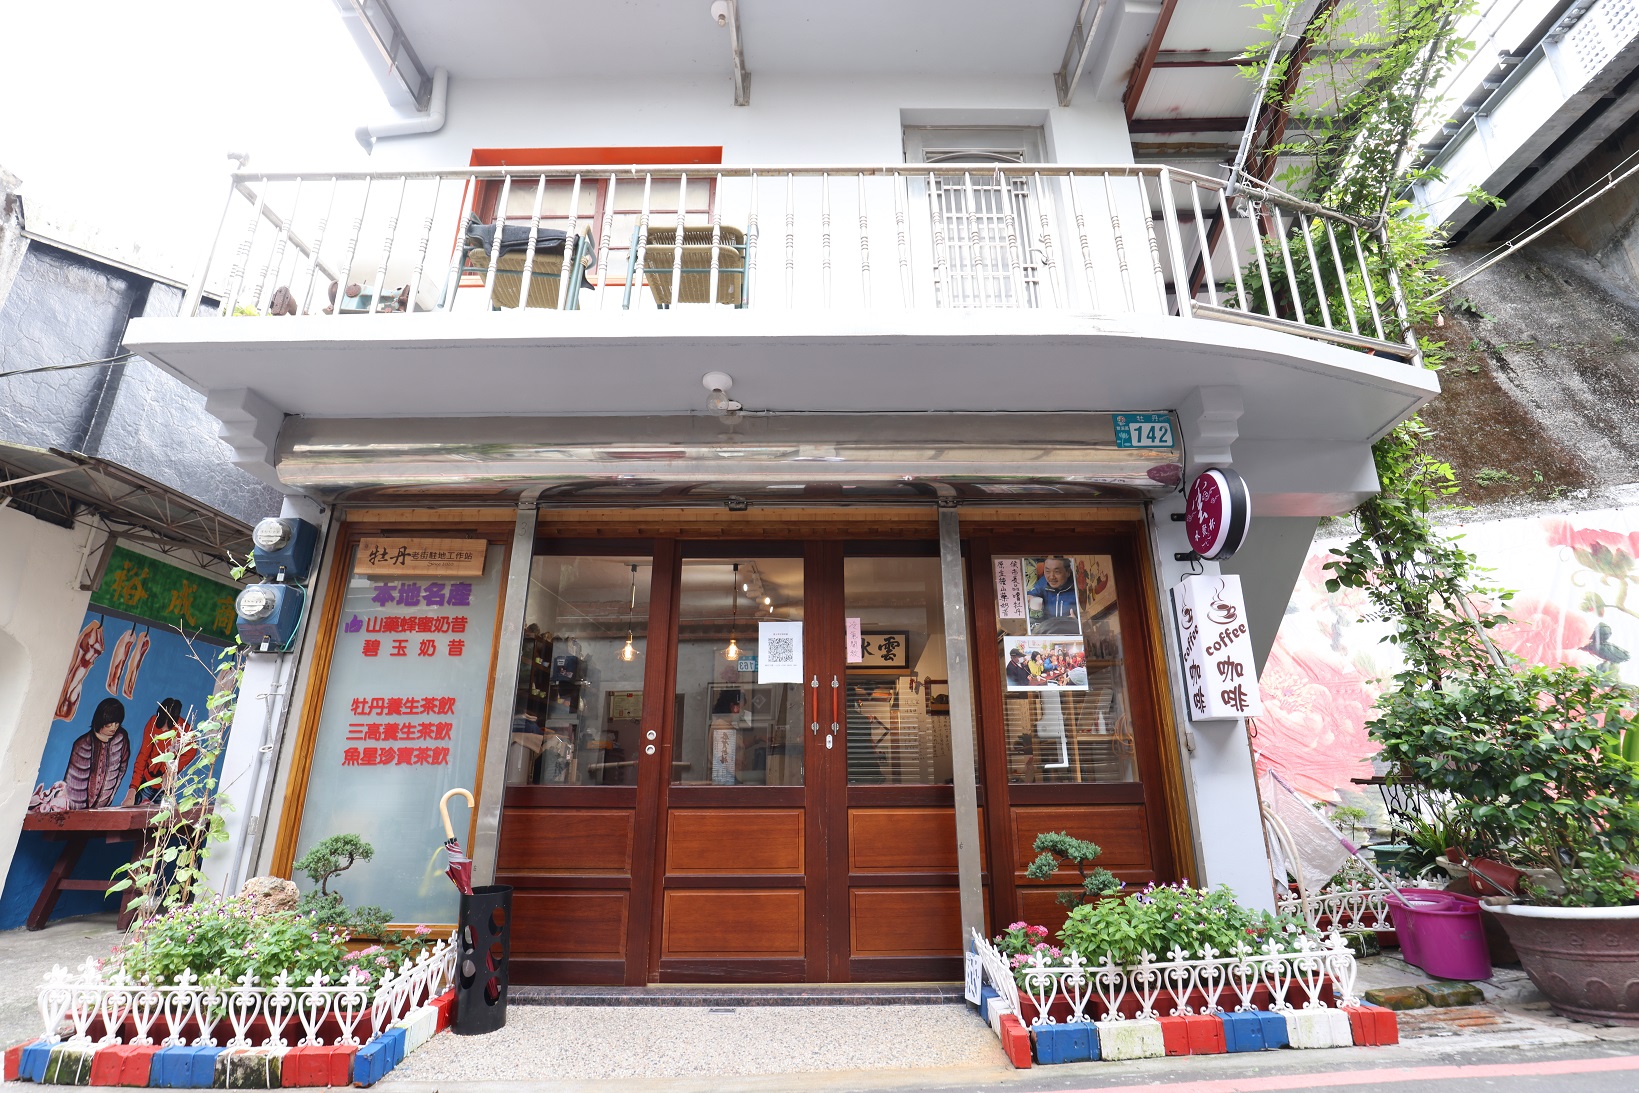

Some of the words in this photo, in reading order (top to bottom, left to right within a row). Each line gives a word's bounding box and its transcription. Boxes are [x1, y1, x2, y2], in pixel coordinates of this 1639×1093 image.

[1134, 426, 1168, 443] 142
[368, 545, 411, 566] 牡丹
[371, 582, 472, 607] 本地名產
[366, 616, 468, 633] 山藥蜂蜜奶昔
[1183, 624, 1199, 663] coffee
[1205, 623, 1247, 657] coffee
[1189, 659, 1206, 714] 咖啡
[1216, 655, 1250, 713] 咖啡
[351, 697, 456, 716] 牡丹養生茶飲
[346, 722, 453, 741] 三高養生茶飲
